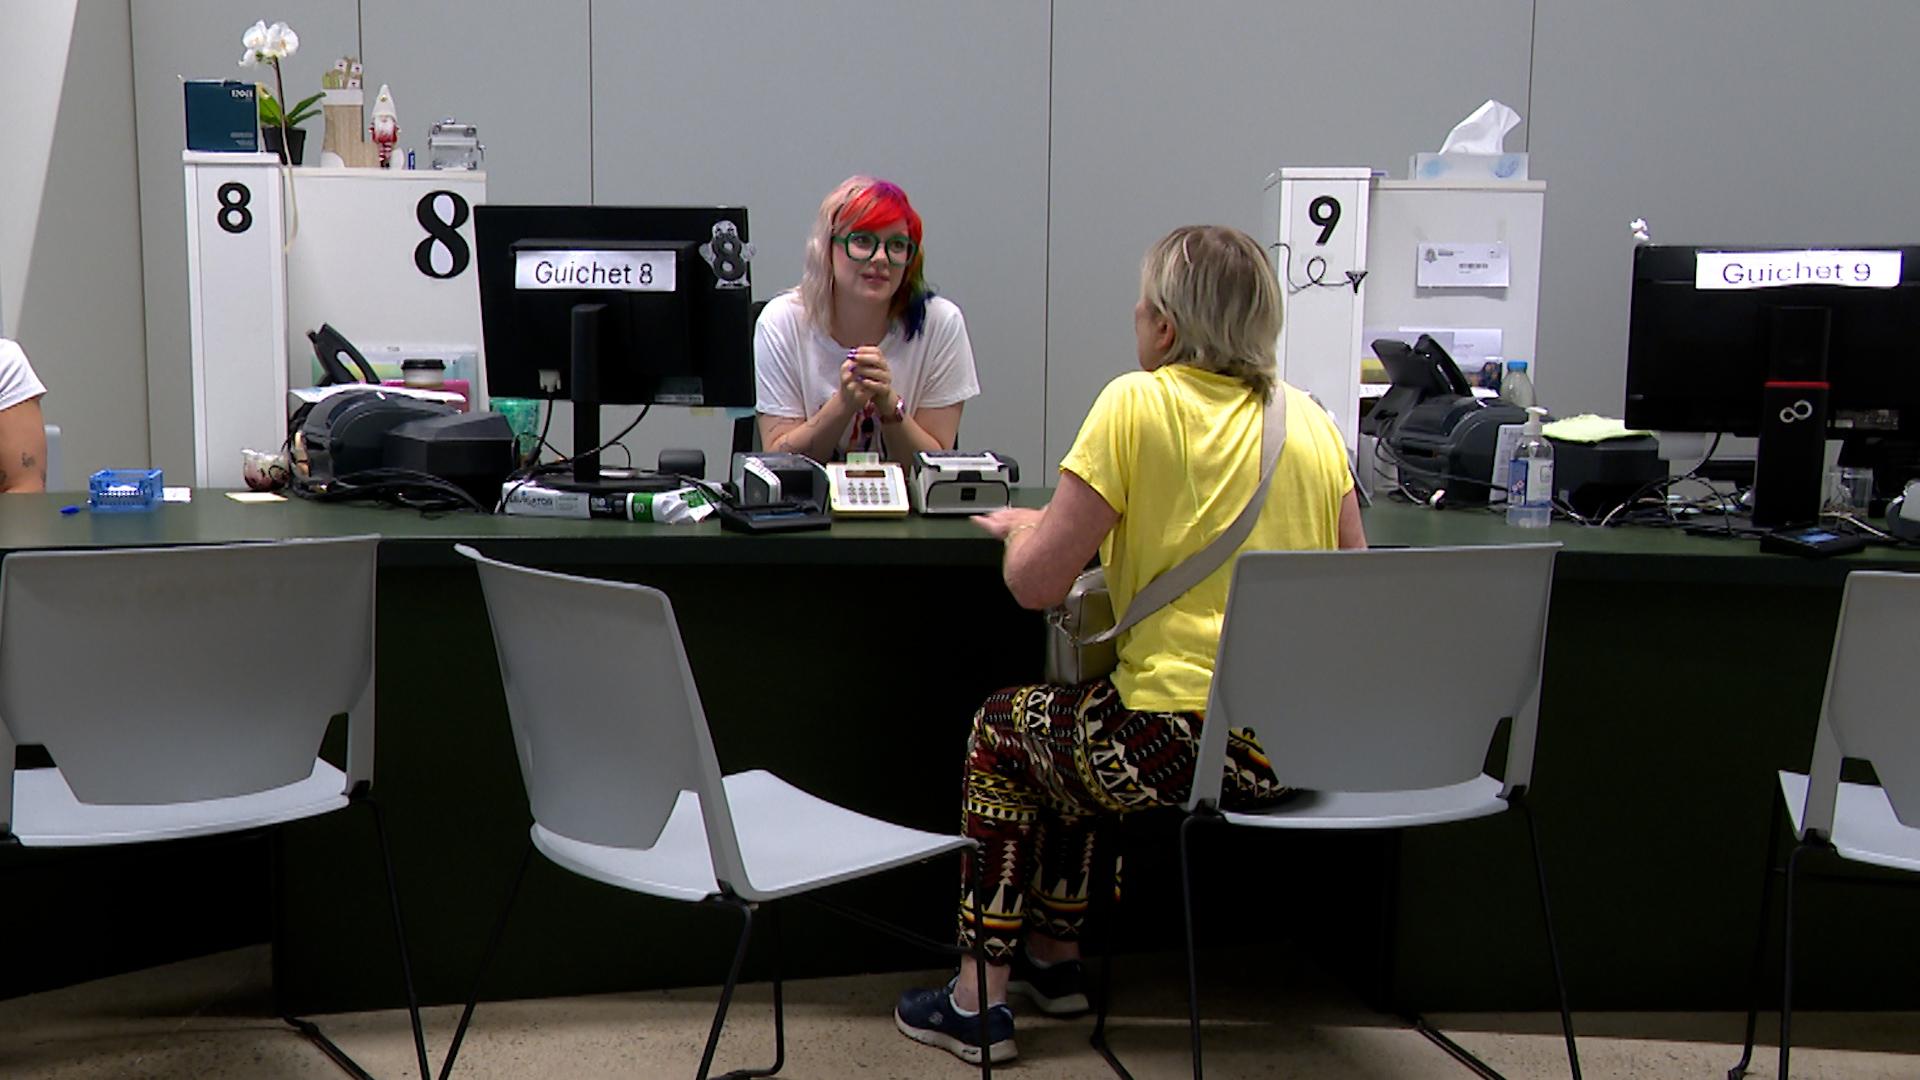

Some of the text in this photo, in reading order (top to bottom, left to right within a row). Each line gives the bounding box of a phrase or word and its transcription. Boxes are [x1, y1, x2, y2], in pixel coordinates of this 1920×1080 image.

[217, 183, 252, 233] 8
[1309, 196, 1341, 245] 9
[415, 190, 470, 279] 8
[712, 233, 746, 281] 8
[535, 260, 653, 285] Guichet 8
[1722, 262, 1871, 284] Guichet 9
